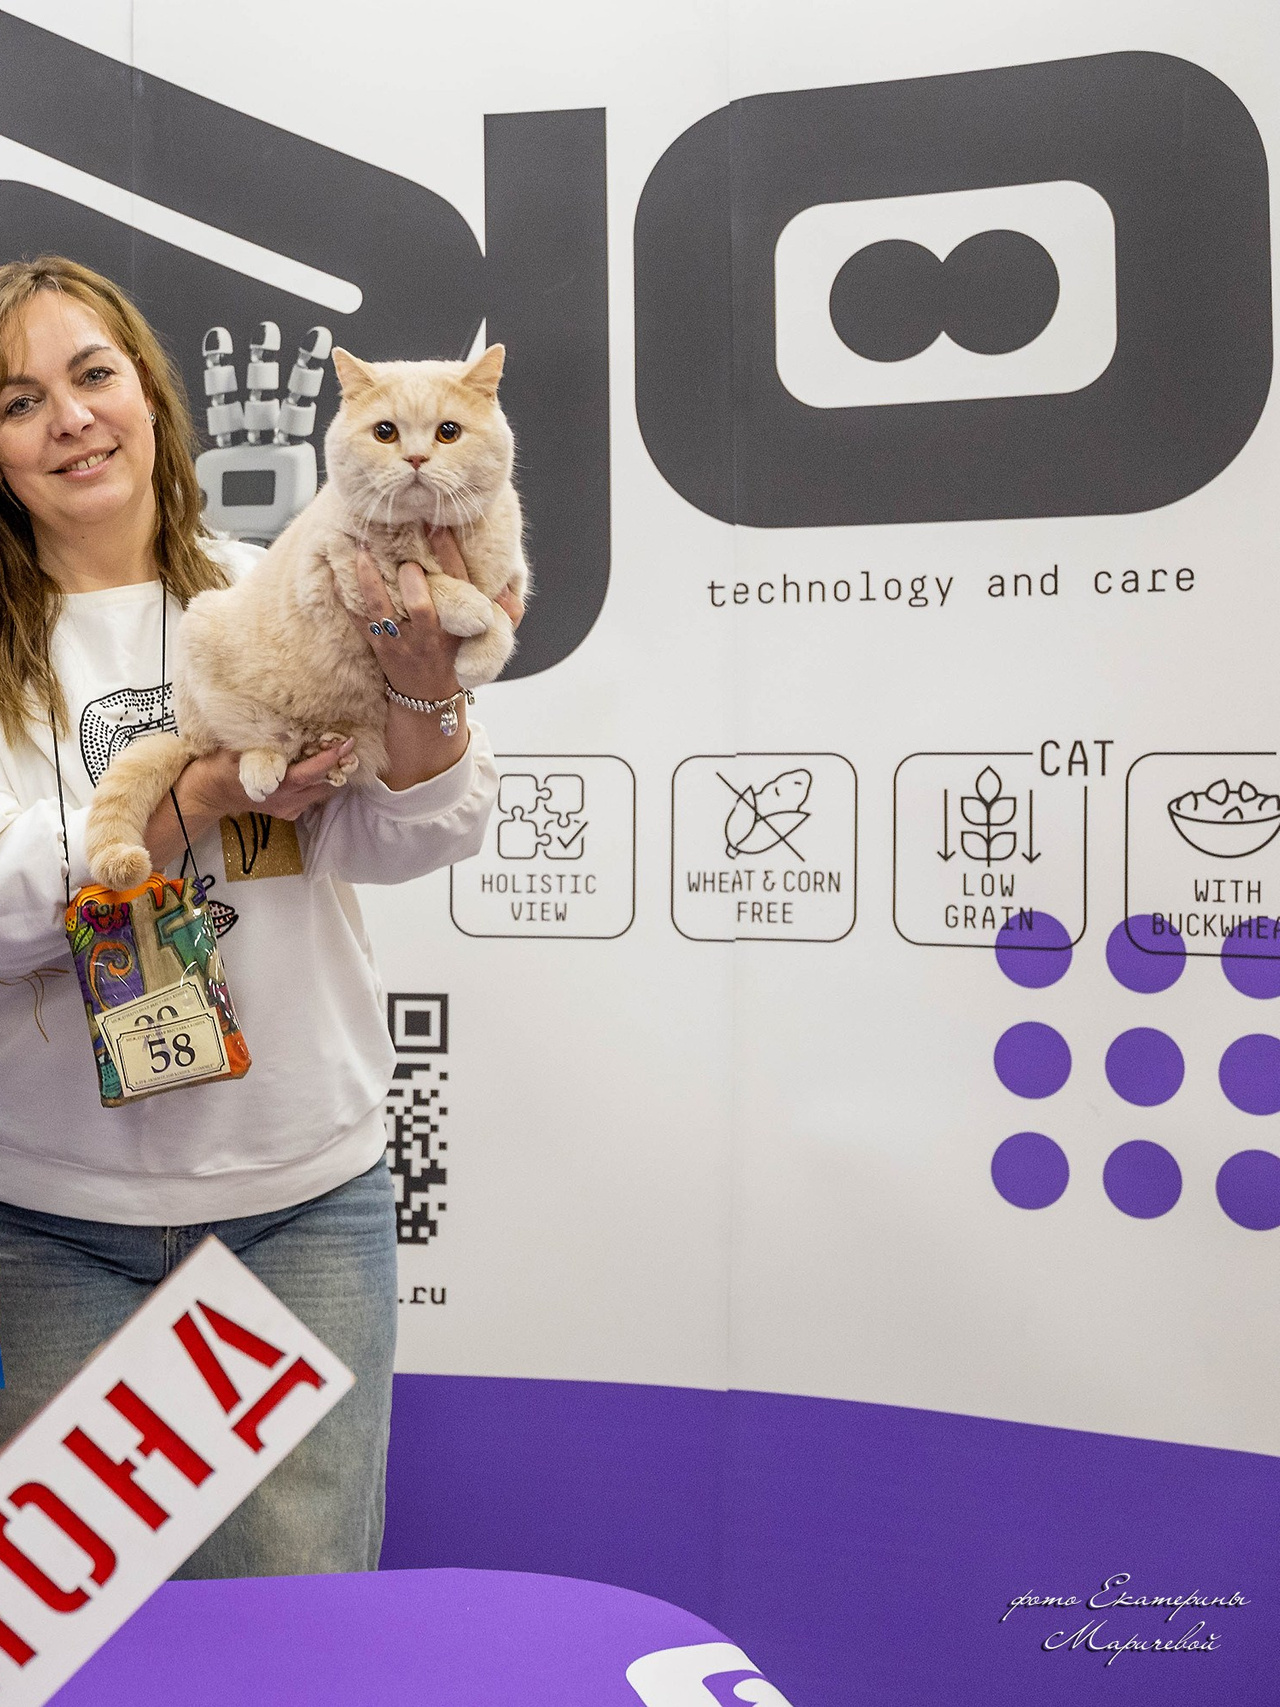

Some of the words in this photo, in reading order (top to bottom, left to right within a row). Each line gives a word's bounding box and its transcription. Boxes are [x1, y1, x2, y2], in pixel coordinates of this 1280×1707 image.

[707, 571, 954, 608] technology
[987, 564, 1060, 598] and
[1093, 565, 1196, 594] care
[1040, 739, 1114, 776] CAT
[481, 873, 598, 894] HOLISTIC
[687, 870, 754, 893] WHEAT
[762, 870, 776, 892] &
[783, 871, 842, 893] CORN
[963, 873, 1015, 897] LOW
[1194, 879, 1262, 904] WITH
[511, 901, 568, 922] VIEW
[736, 902, 794, 924] FREE
[945, 904, 1034, 931] GRAIN
[1151, 912, 1280, 941] BUCKWHEA
[147, 1032, 196, 1074] 58
